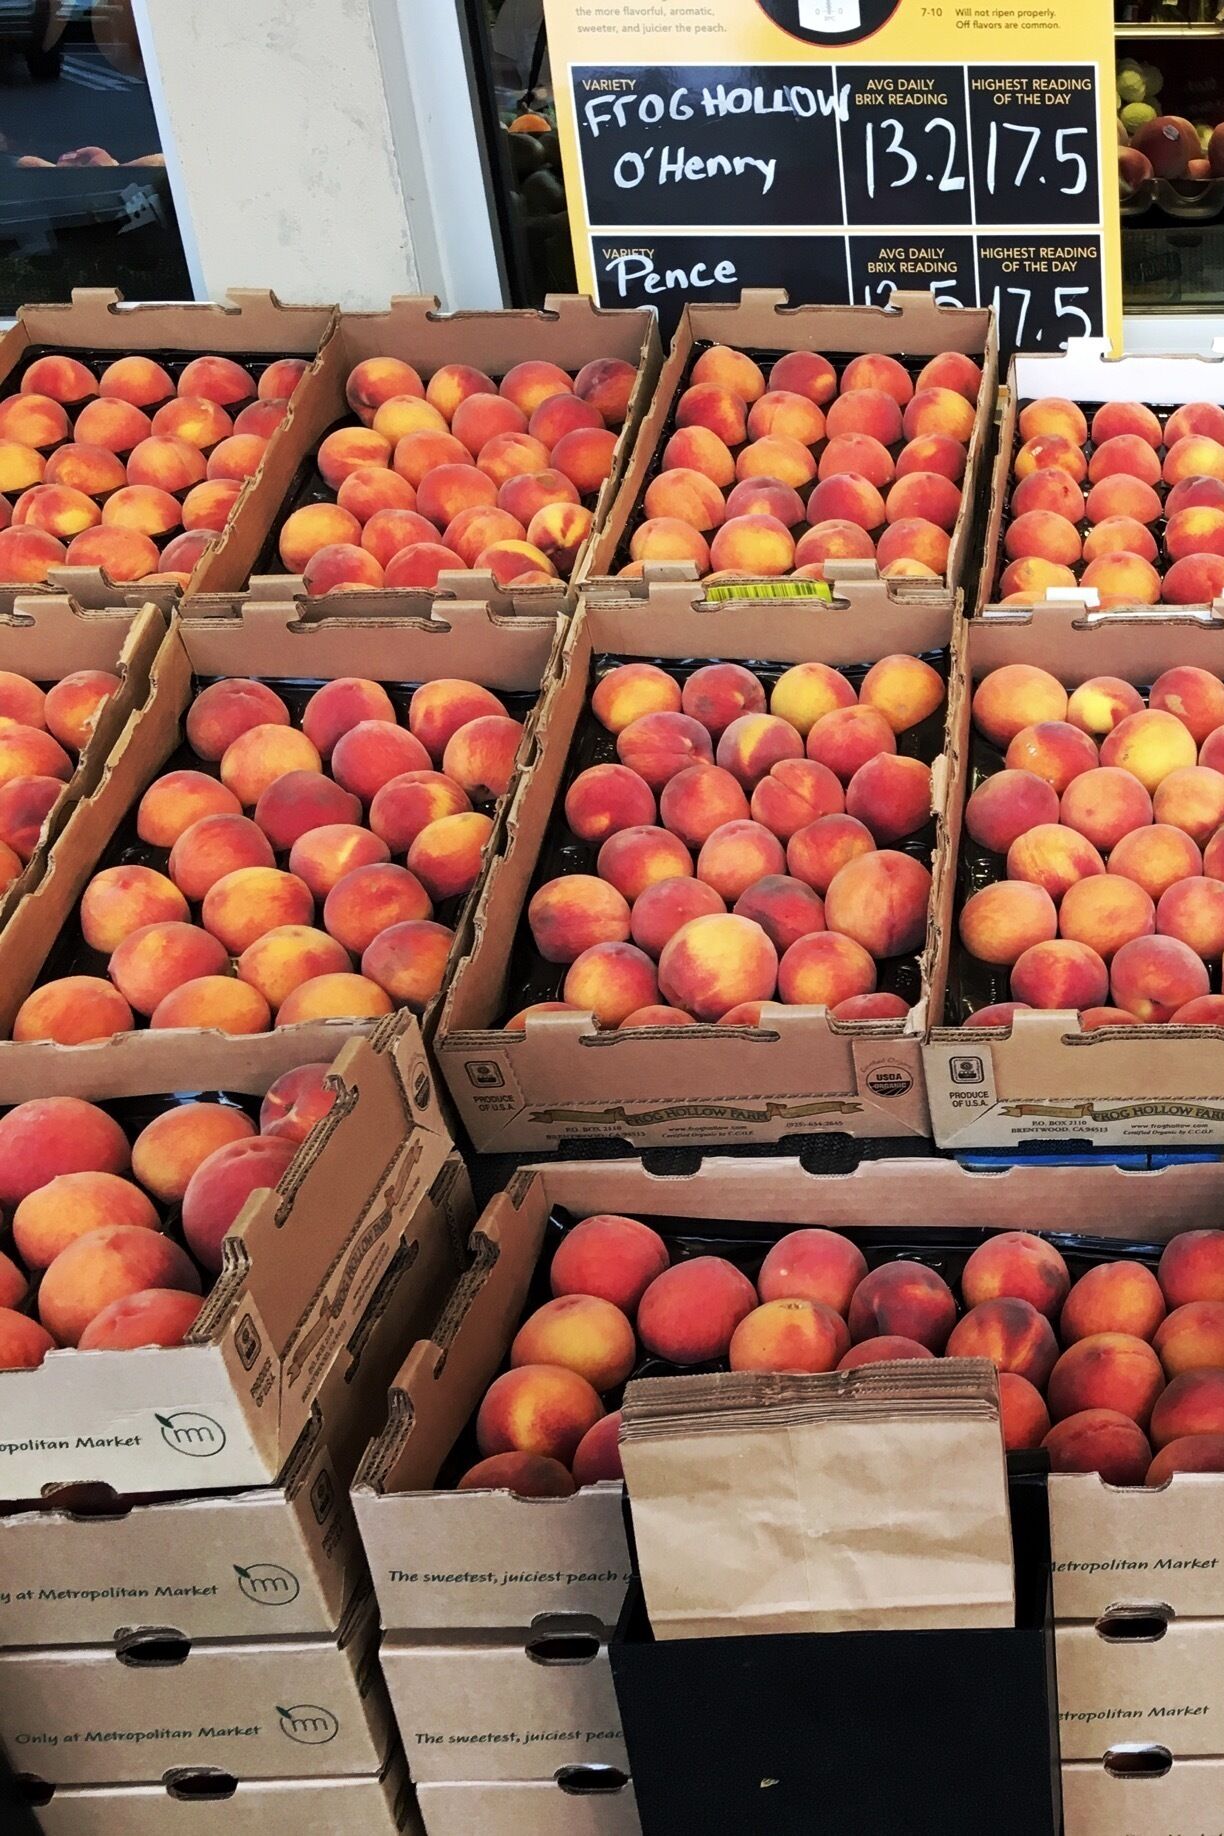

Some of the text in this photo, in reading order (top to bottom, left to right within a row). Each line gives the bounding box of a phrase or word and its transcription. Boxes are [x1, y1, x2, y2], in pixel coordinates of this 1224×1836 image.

[576, 7, 592, 16] the
[921, 8, 943, 16] 7-10
[955, 8, 973, 16] Will
[992, 8, 1014, 19] ripen
[1018, 8, 1056, 19] properly.
[578, 24, 727, 35] sweeter, and juicier the peach.
[956, 20, 970, 29] Off
[972, 20, 1002, 29] flavors
[582, 80, 636, 91] VARIETY
[867, 79, 934, 90] AVG DAILY
[972, 79, 1092, 90] HIGHEST READING
[701, 84, 852, 122] HOLLOW
[856, 94, 948, 106] BRIX READING
[994, 94, 1072, 105] OF THE DAY
[865, 117, 966, 199] 13.2
[986, 121, 1088, 195] 17.5
[613, 146, 777, 195] O'Henry
[878, 248, 945, 260] AVG DAILY
[981, 248, 1098, 258] HIGHEST READING
[868, 262, 958, 273] BRIX READING
[1002, 261, 1078, 272] OF THE DAY
[605, 255, 738, 298] Pence
[994, 285, 1092, 350] 17.5
[876, 1074, 902, 1082] USDA
[473, 1095, 515, 1103] PRODUCE
[952, 1100, 964, 1108] OF
[478, 1103, 516, 1112] OF U.S.A.
[1094, 1108, 1130, 1121] FROG
[1134, 1104, 1193, 1116] HOLLOW
[625, 1107, 769, 1126] FROG HOLLOW FARM
[76, 1434, 142, 1448] Market
[1152, 1558, 1220, 1570] Market
[388, 1570, 418, 1582] The
[422, 1571, 498, 1584] sweetest,
[500, 1570, 562, 1586] juiciest
[566, 1570, 618, 1585] peach
[16, 1590, 34, 1600] at
[38, 1584, 150, 1602] Metropolitan
[154, 1583, 218, 1598] Market
[1147, 1705, 1210, 1717] Market
[16, 1724, 262, 1747] Only at Metropolitan Market
[415, 1729, 582, 1744] The sweetest, juiciest
